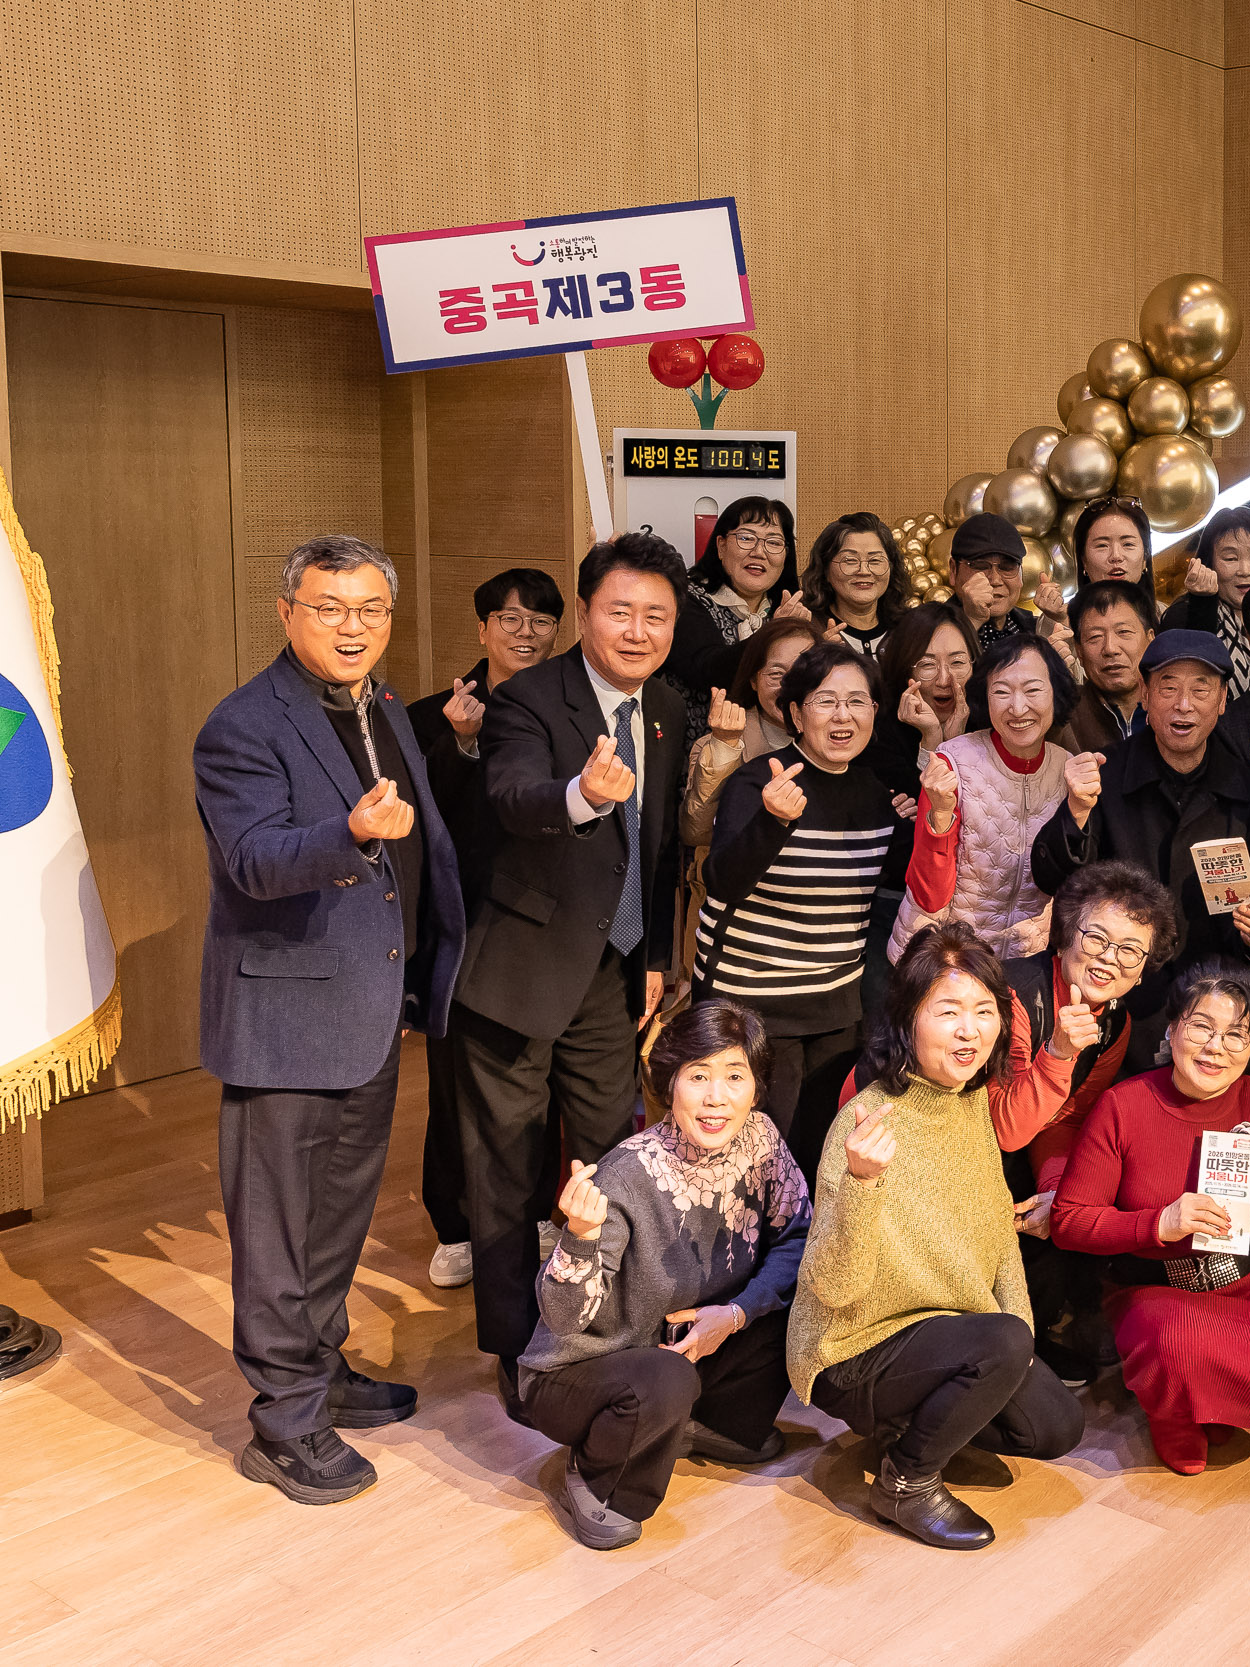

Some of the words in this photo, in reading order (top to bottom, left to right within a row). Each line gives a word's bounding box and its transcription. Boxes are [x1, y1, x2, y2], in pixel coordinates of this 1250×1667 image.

[551, 245, 598, 263] 행복광진
[438, 263, 687, 334] 중곡제3동
[631, 445, 669, 469] 사랑의
[673, 446, 699, 469] 온도
[1201, 858, 1243, 870] 따뜻한
[1204, 866, 1245, 876] 겨울나기
[1206, 1158, 1250, 1173] 따뜻한
[1205, 1171, 1247, 1184] 겨울나기
